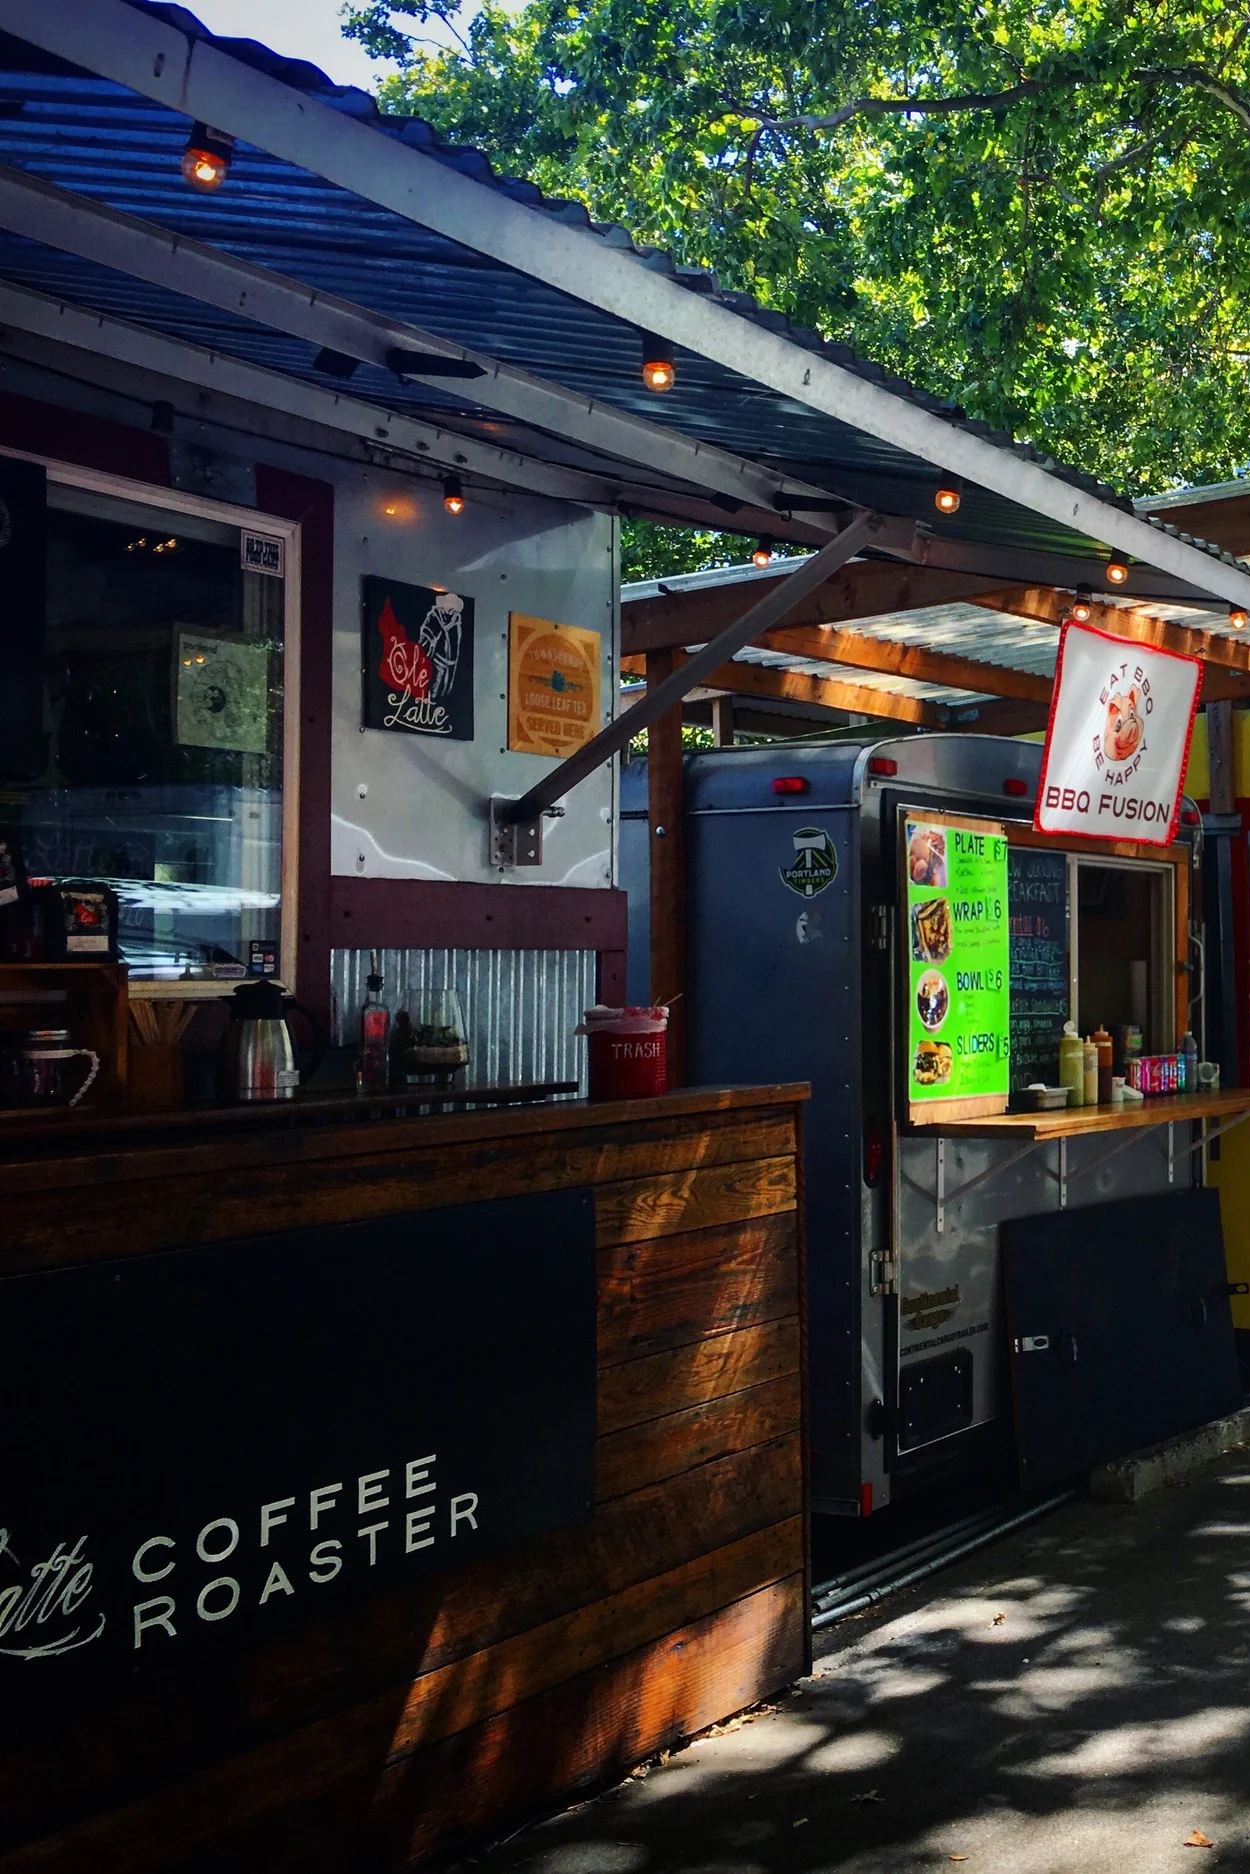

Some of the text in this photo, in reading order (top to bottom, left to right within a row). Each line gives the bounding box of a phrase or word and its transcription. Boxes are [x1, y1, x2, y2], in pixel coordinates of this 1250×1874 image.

[1099, 663, 1154, 716] EAT BBQ
[383, 684, 453, 733] Latte
[524, 691, 587, 716] LOOSE LEAF TEA
[525, 716, 585, 740] SERVED HERE
[1092, 734, 1148, 787] BE HAPPY
[1045, 785, 1171, 824] BBQ FUSION
[955, 832, 985, 856] PLATE
[786, 868, 832, 878] PORTLAND
[953, 900, 984, 922] WRAP
[956, 971, 984, 992] BOWL
[611, 1042, 661, 1060] TRASH
[956, 1033, 995, 1055] SLIDERS
[132, 1453, 438, 1584] COFFEE
[133, 1491, 480, 1649] ROASTER
